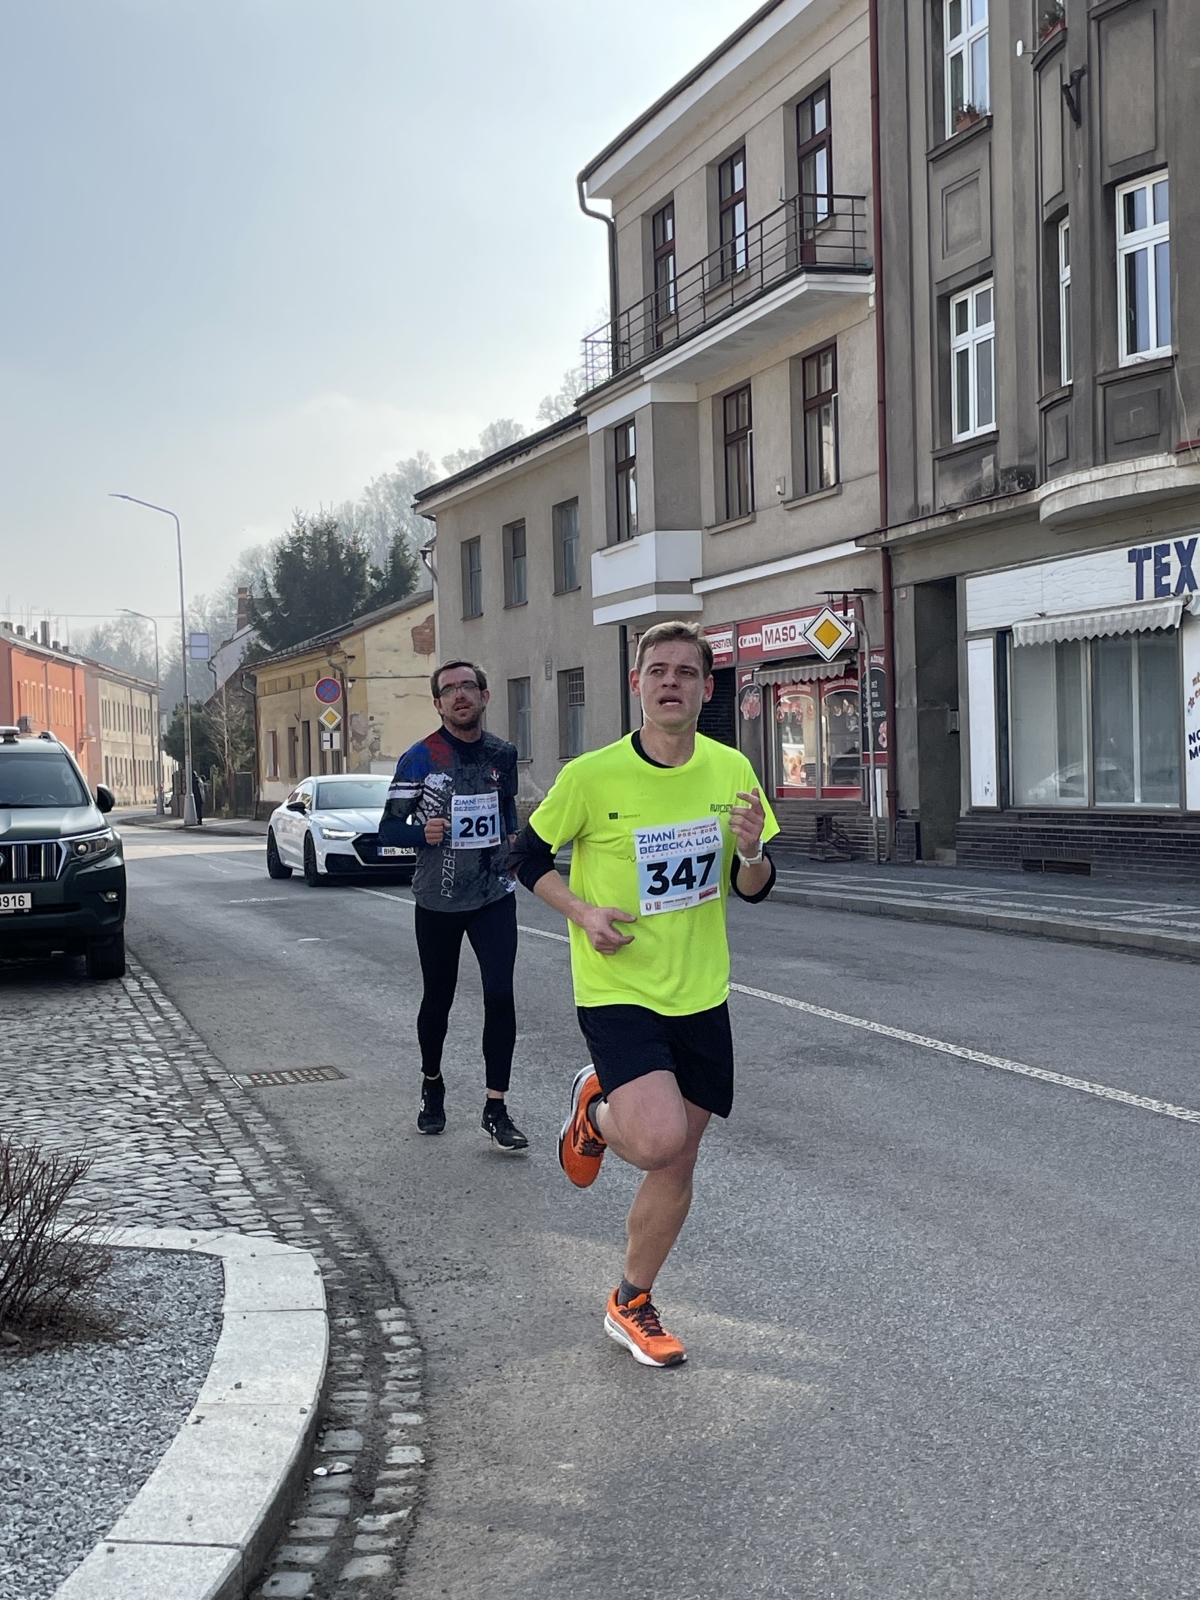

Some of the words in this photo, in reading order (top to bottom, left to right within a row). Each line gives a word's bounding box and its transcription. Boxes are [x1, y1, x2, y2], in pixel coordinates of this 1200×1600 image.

[1127, 537, 1199, 601] TEX
[764, 625, 796, 646] MASO
[459, 814, 496, 838] 261
[638, 828, 676, 844] ZIMNÍ
[639, 839, 693, 855] BĚŽECKÁ
[696, 835, 720, 846] LIGA
[646, 852, 716, 896] 347
[0, 895, 25, 908] 916
